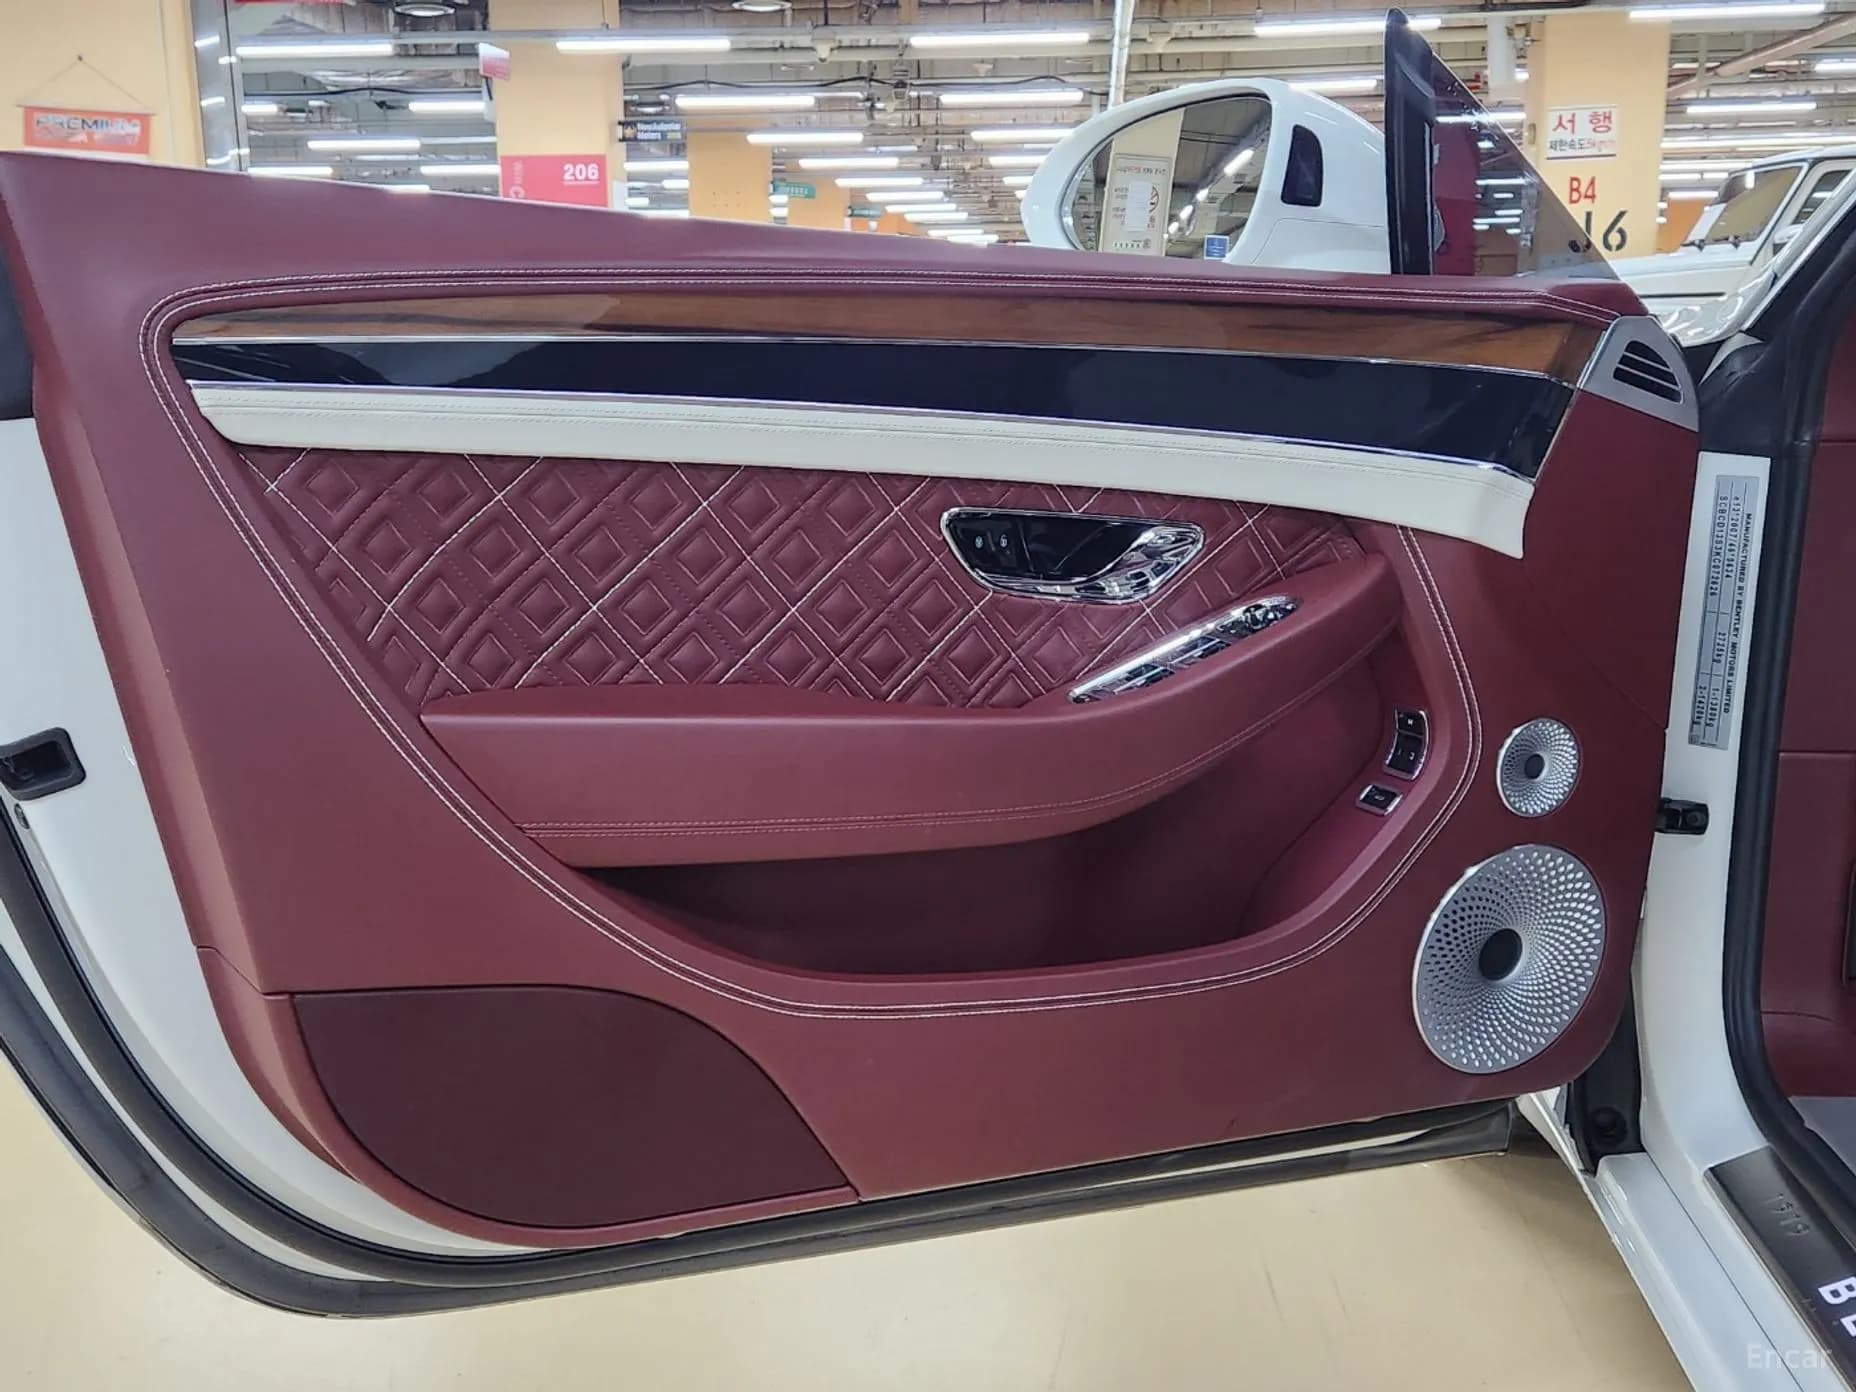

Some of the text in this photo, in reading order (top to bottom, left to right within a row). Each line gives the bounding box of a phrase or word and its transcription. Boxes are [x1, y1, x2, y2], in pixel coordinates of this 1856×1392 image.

[563, 163, 600, 181] 206
[1568, 176, 1597, 205] B4
[1723, 512, 1752, 714] MANUFACTURED BY BENTLEY MOTORS LIMITED
